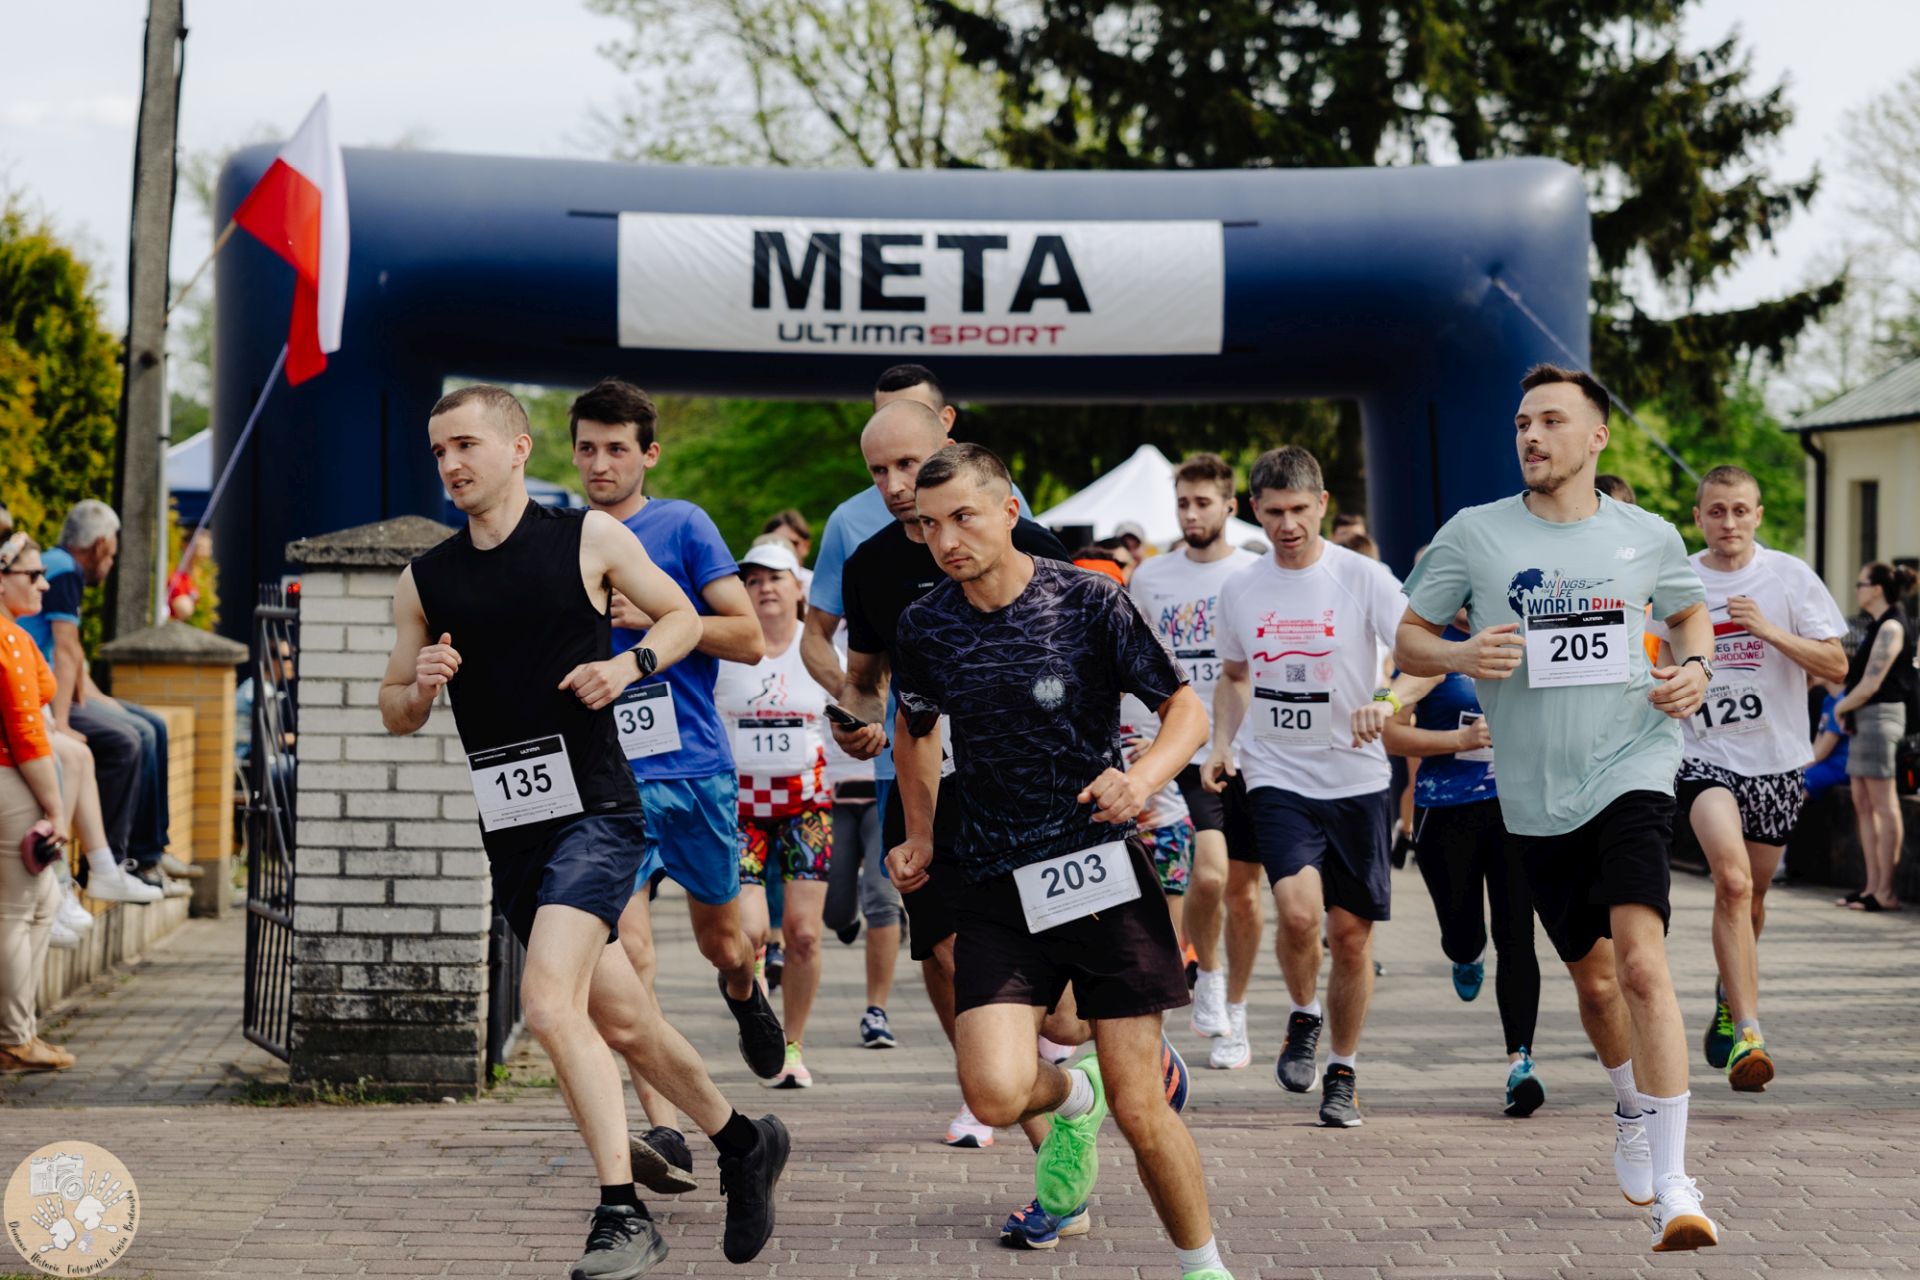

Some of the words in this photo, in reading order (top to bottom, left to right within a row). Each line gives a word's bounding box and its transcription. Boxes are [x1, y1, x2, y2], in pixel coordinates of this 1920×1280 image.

[751, 230, 1092, 314] META
[777, 322, 1066, 345] ULTIMASPORT
[1550, 632, 1608, 662] 205
[1733, 640, 1764, 652] FLAGI
[619, 706, 655, 734] 39
[1270, 707, 1311, 730] 120
[1695, 694, 1763, 728] 129
[752, 733, 790, 752] 113
[495, 763, 552, 800] 135
[1041, 853, 1107, 899] 203
